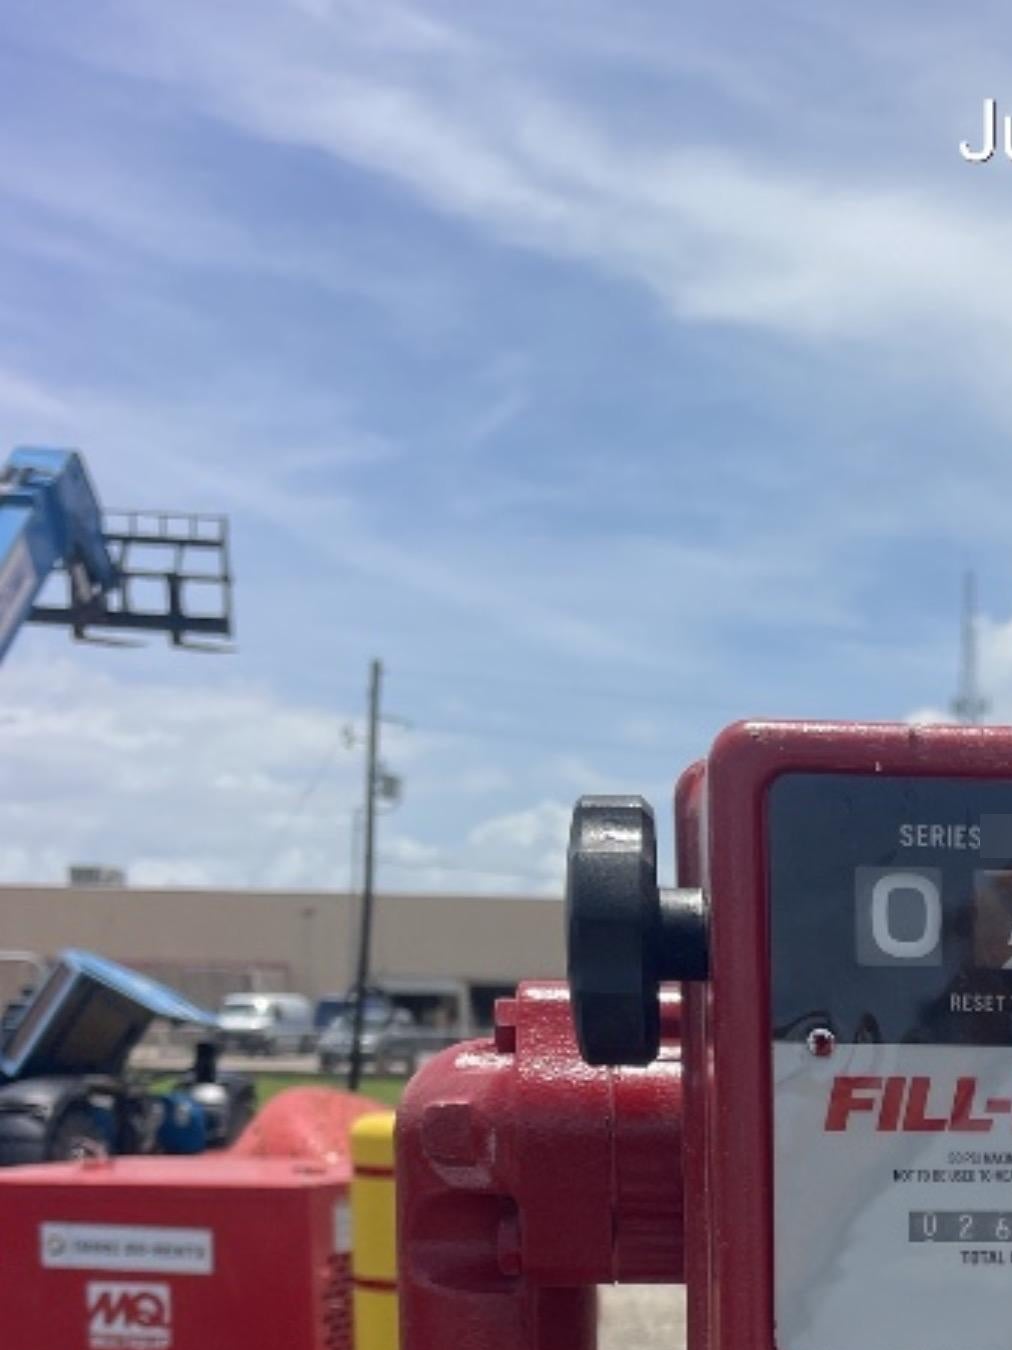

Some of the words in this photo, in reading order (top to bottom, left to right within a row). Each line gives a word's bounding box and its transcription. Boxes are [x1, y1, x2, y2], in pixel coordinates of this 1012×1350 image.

[899, 823, 981, 849] SERIES
[871, 871, 943, 959] 0
[950, 993, 1005, 1013] RESET
[960, 1250, 1005, 1265] TOTAL
[92, 1291, 171, 1328] MQ
